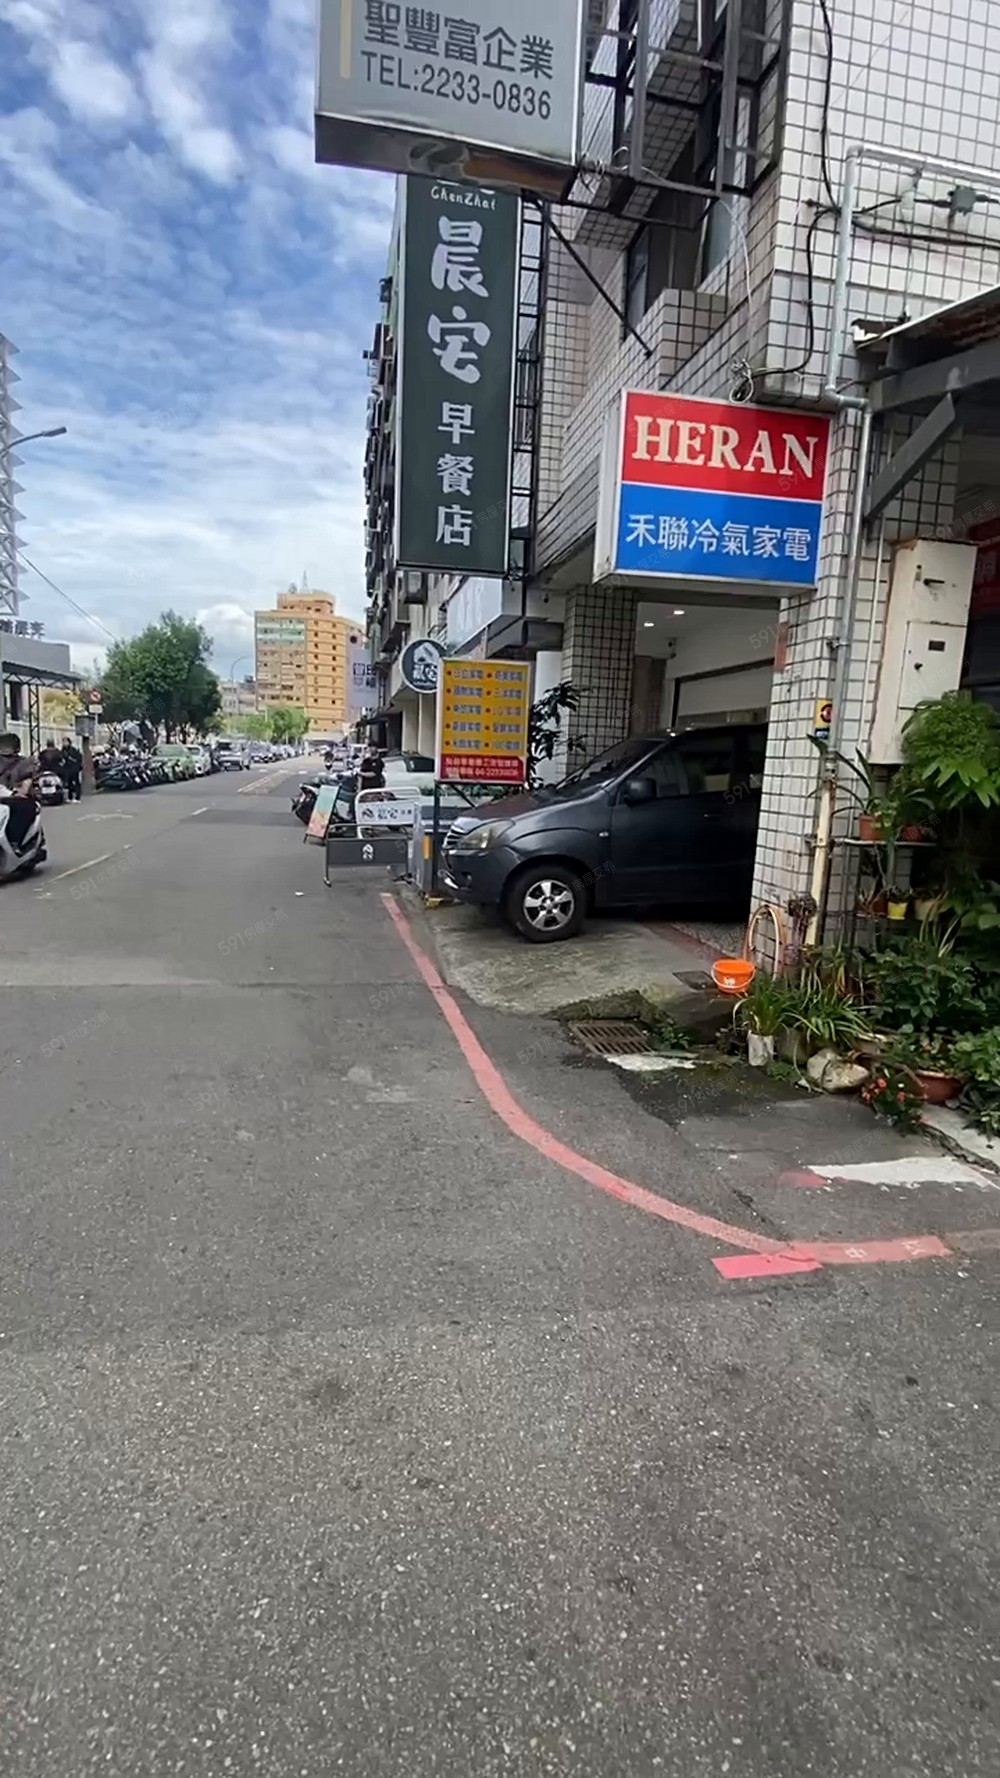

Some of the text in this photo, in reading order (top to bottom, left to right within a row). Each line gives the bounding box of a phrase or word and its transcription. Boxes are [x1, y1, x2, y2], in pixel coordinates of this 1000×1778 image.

[364, 0, 554, 79] 聖豐富企業
[361, 50, 551, 120] TEL:2233-0836
[631, 415, 819, 479] HERAN
[625, 513, 811, 562] 禾聯冷氣家電
